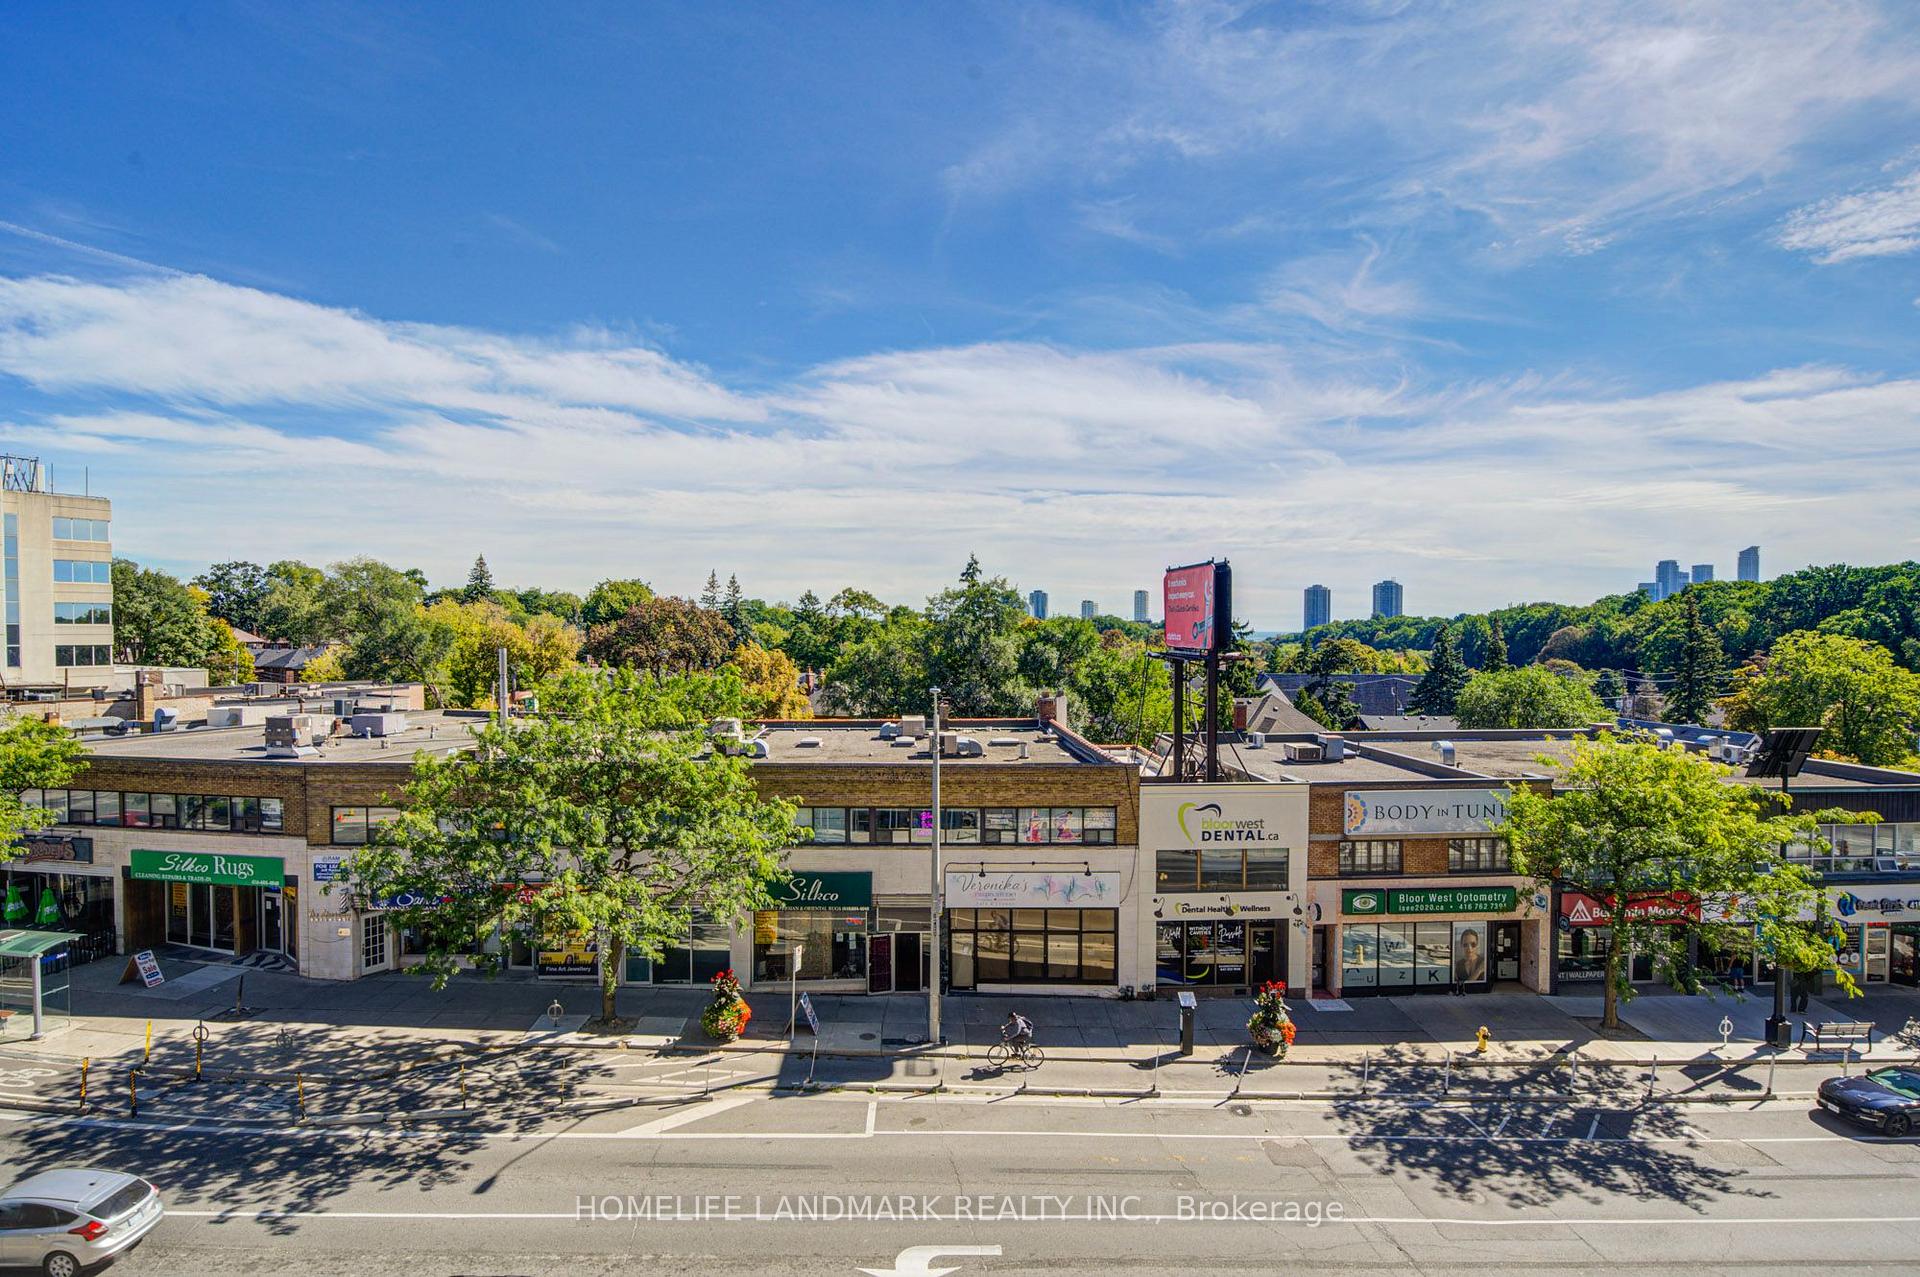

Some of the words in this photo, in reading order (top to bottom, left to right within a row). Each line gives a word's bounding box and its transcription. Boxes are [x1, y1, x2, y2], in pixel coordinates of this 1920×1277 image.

[1375, 805, 1434, 819] BODY
[1437, 808, 1449, 816] IN
[1201, 830, 1279, 841] DENTAL.ca
[158, 854, 208, 873] Silkco
[212, 855, 254, 879] Rugs
[780, 878, 839, 901] Silkco
[959, 873, 1029, 893] Veronika's
[1399, 893, 1424, 903] Bloor
[1428, 893, 1453, 902] West
[1456, 892, 1507, 903] Optometry
[1182, 905, 1205, 913] Dental
[1240, 904, 1270, 912] Wellness
[1428, 970, 1439, 982] K
